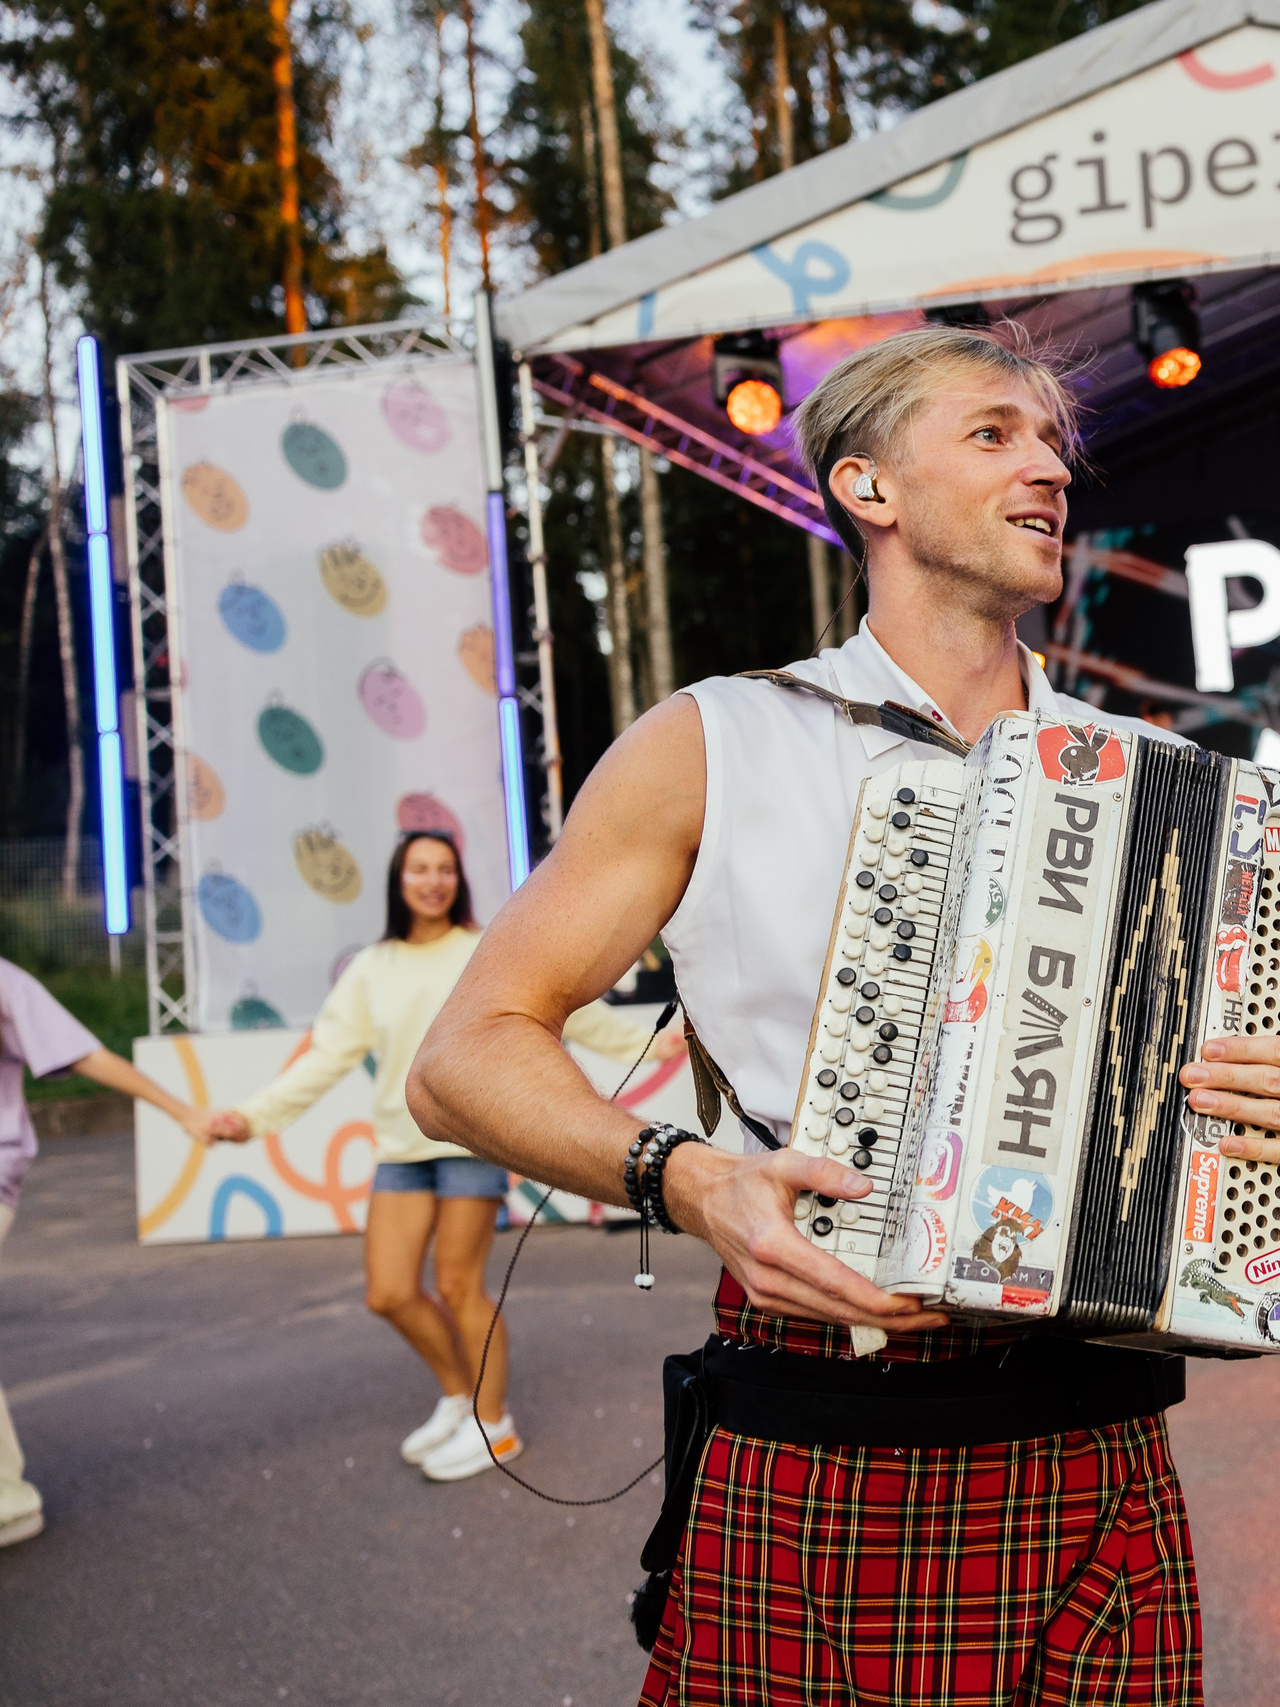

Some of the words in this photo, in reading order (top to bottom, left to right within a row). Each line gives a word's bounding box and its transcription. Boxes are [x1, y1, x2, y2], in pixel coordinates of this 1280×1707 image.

[1037, 792, 1099, 916] РВИ
[1236, 870, 1254, 916] NETFLIX
[1191, 1152, 1218, 1241] Supreme
[963, 1263, 1047, 1286] TOMY
